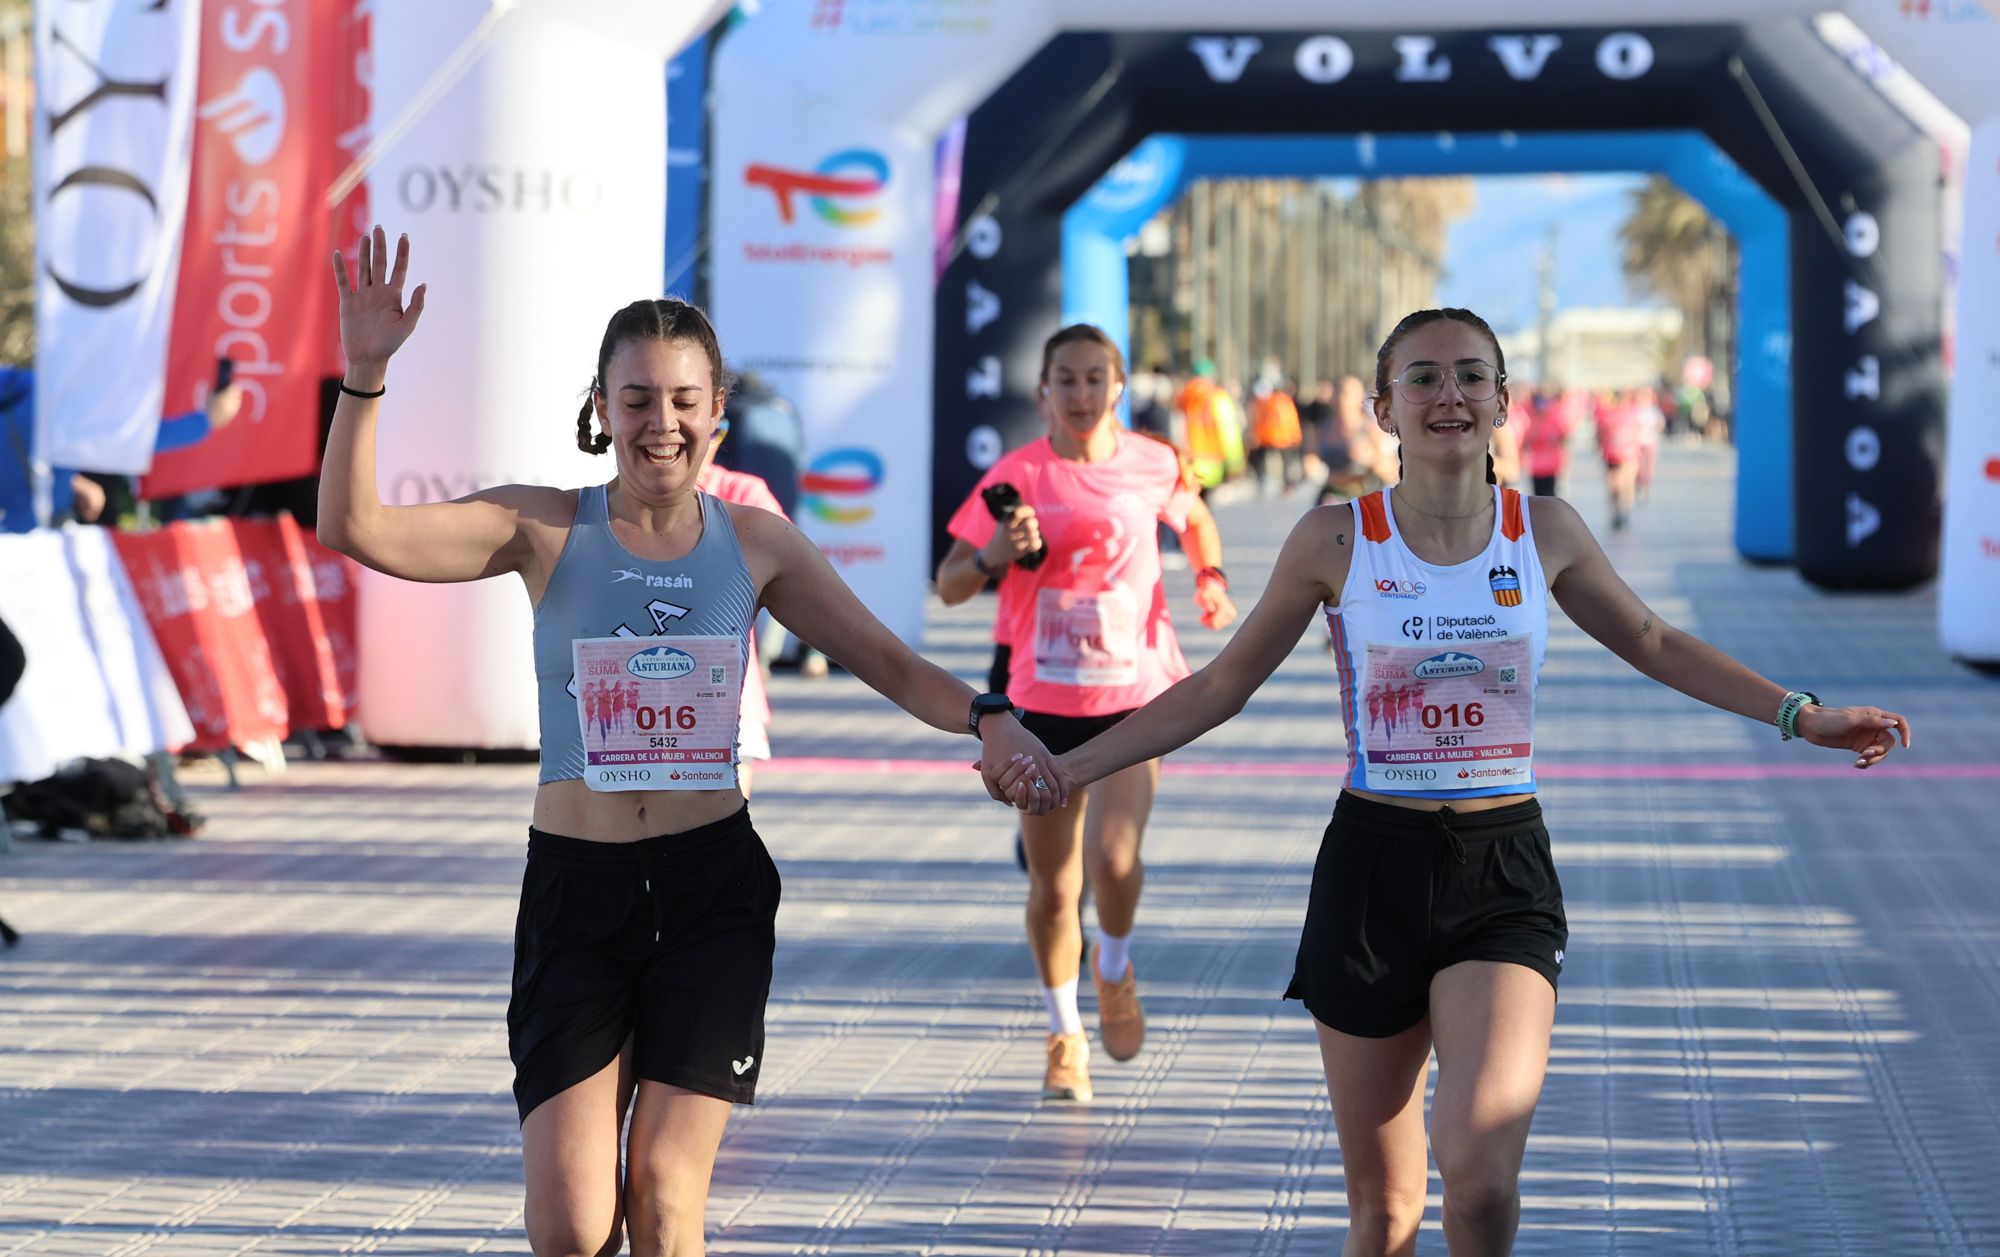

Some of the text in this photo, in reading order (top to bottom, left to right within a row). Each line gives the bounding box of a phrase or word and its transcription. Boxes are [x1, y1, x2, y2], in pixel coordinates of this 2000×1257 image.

[1187, 31, 1655, 84] VOLVO
[397, 166, 602, 213] OYSHO
[966, 216, 1002, 470] OLVO
[1844, 212, 1880, 548] VOLVO
[646, 573, 693, 589] rasán
[1380, 592, 1418, 600] CENTENARIO
[1436, 614, 1496, 628] Diputació
[1436, 630, 1454, 640] de
[588, 666, 621, 676] SUMA
[1374, 670, 1407, 680] SUMA
[636, 705, 697, 730] 016
[1421, 702, 1485, 729] 016
[650, 737, 678, 748] 5432
[1435, 735, 1465, 747] 5431
[600, 751, 724, 763] CARRERA DE LA MUJER VALENCIA
[1385, 748, 1513, 762] CARRERA DE LA MUJER VALENCIA
[600, 769, 651, 783] OYSHO
[1385, 769, 1437, 781] OYSHO
